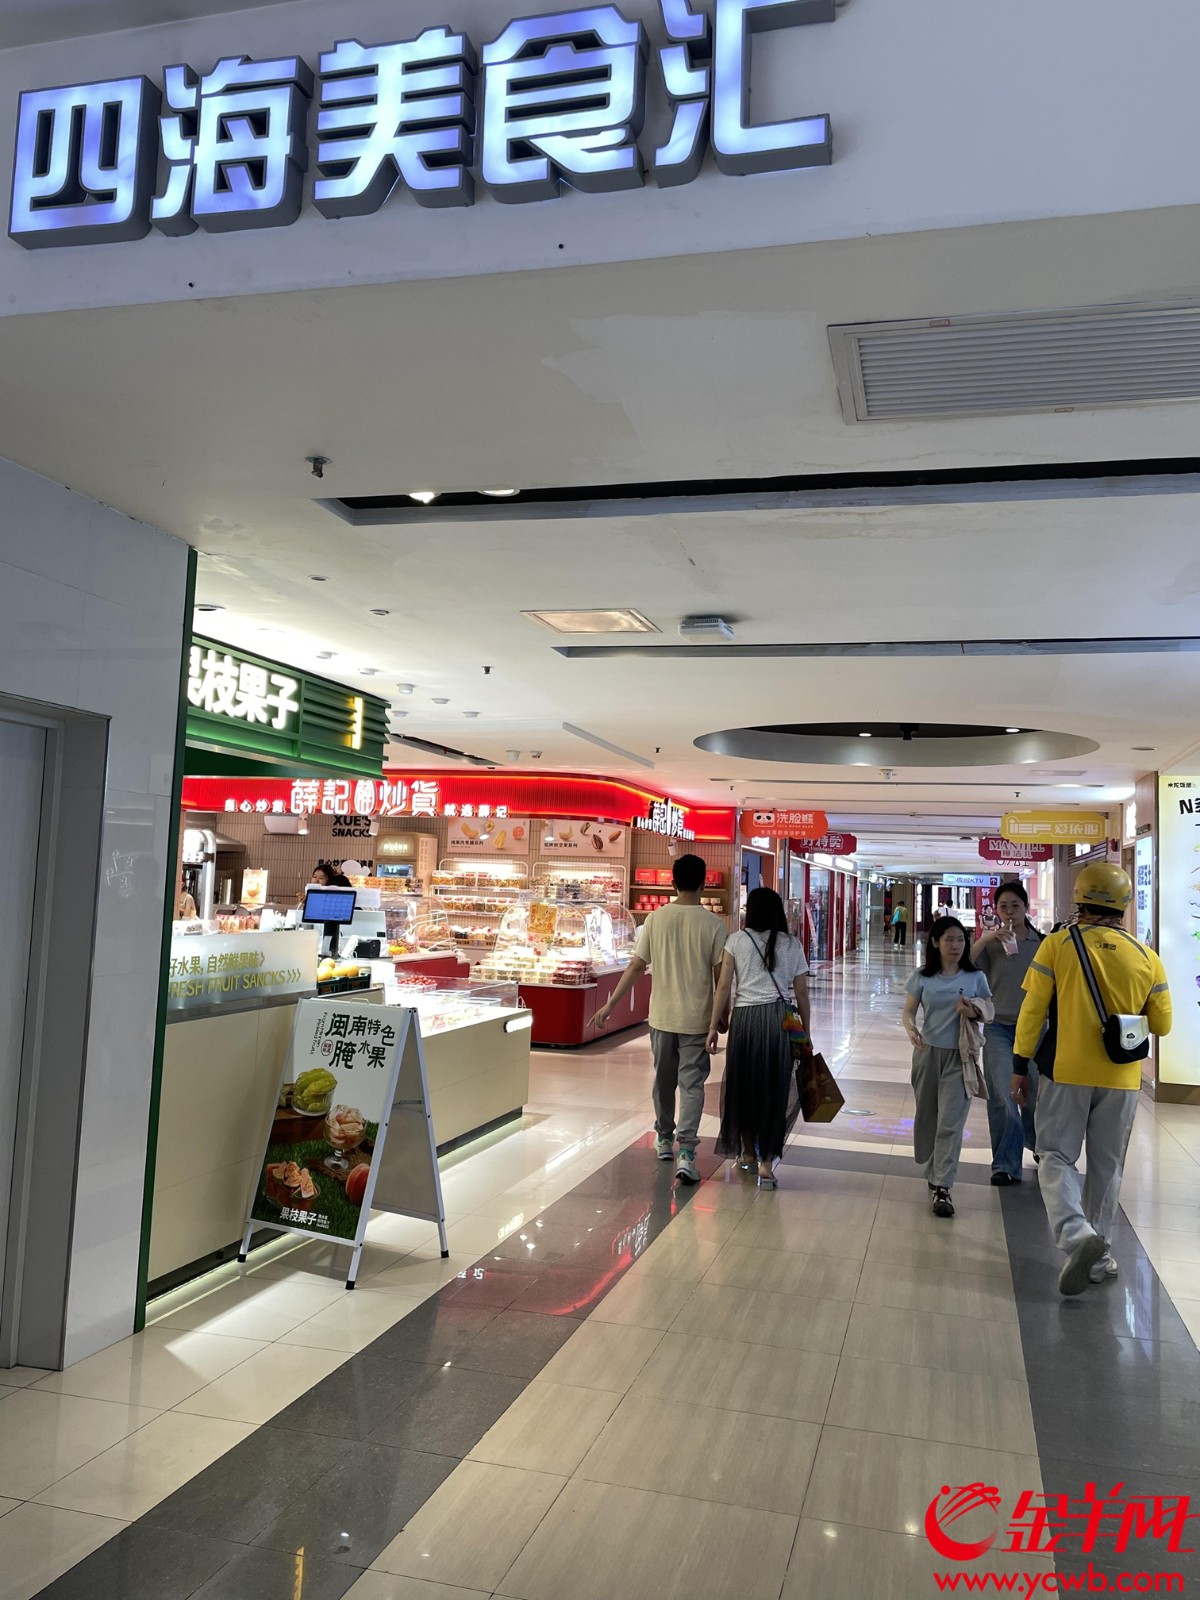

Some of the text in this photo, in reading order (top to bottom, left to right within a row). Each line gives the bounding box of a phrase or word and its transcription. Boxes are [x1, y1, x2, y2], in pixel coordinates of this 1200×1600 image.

[8, 0, 836, 249] 四海美食汇
[333, 815, 371, 826] XUE'S
[777, 813, 814, 825] 洗脸熊
[332, 828, 371, 838] SNACKS
[169, 971, 286, 999] RESH FRUIT SANCKS
[325, 1013, 396, 1047] 闽南特色
[328, 1040, 386, 1069] 腌水果
[279, 1206, 317, 1225] 果枝果子
